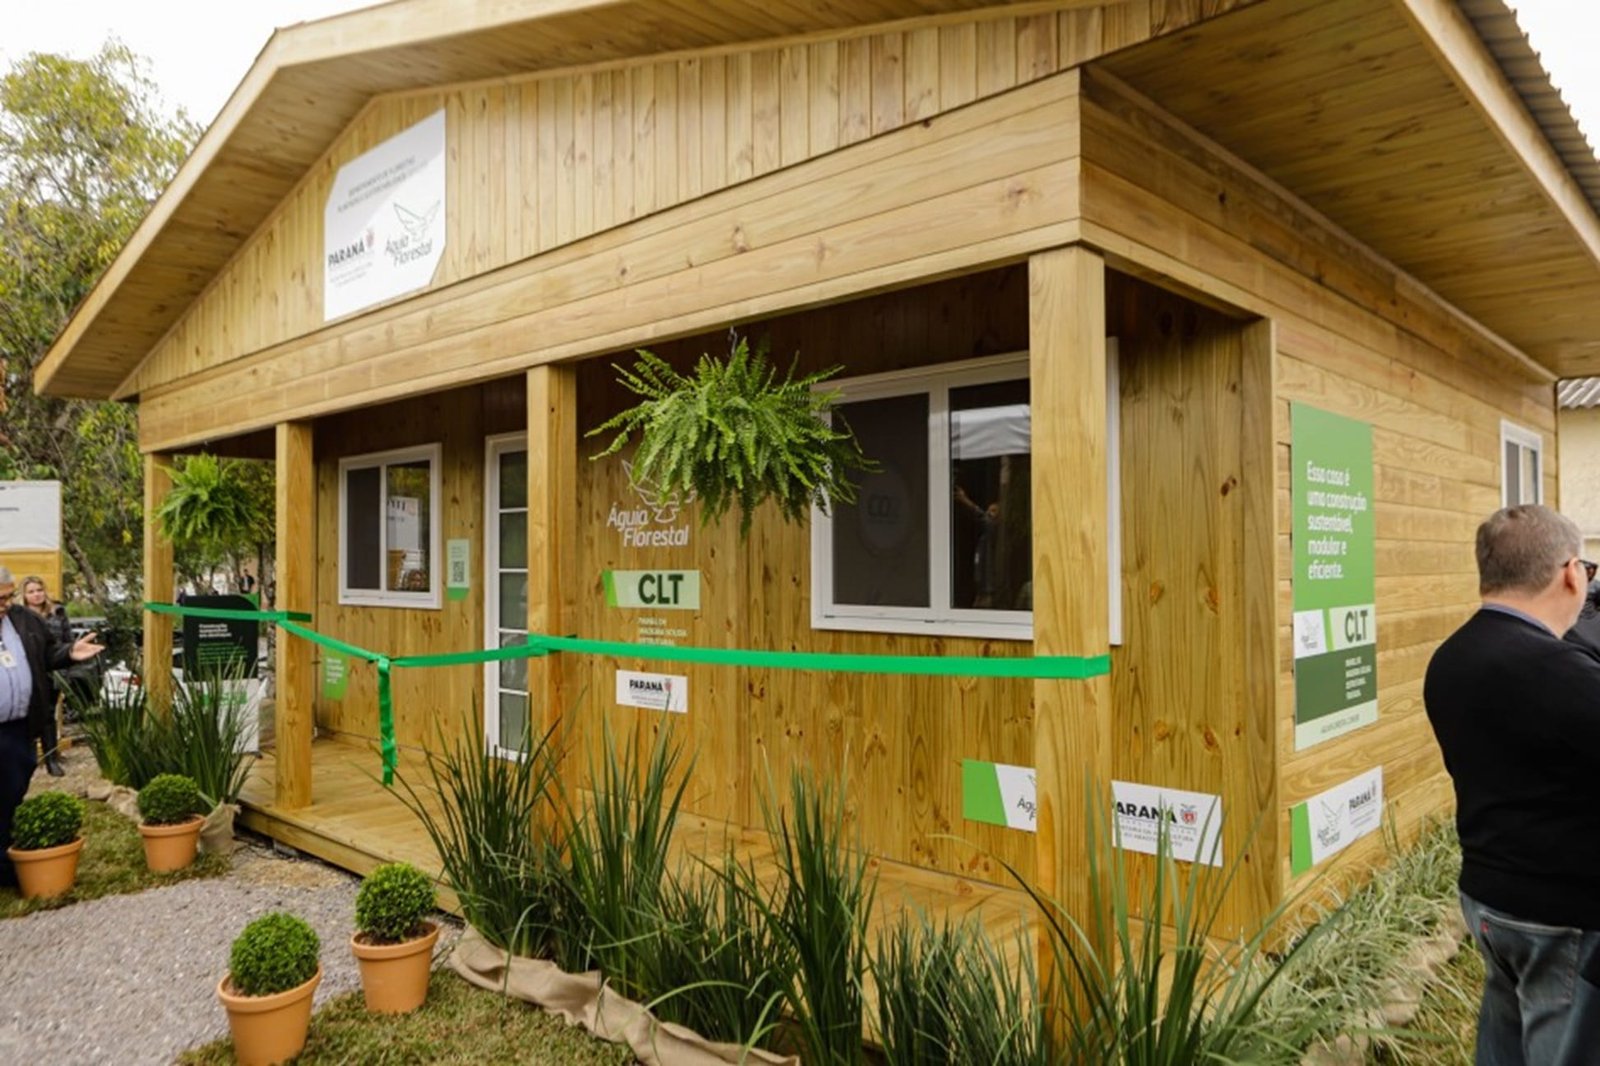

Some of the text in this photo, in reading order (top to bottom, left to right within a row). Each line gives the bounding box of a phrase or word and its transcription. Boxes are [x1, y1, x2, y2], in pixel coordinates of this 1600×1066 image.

[606, 501, 649, 532] Águia
[623, 525, 689, 547] Florestal
[1308, 535, 1347, 556] modular e
[638, 573, 684, 605] CLT
[1344, 609, 1368, 644] CLT
